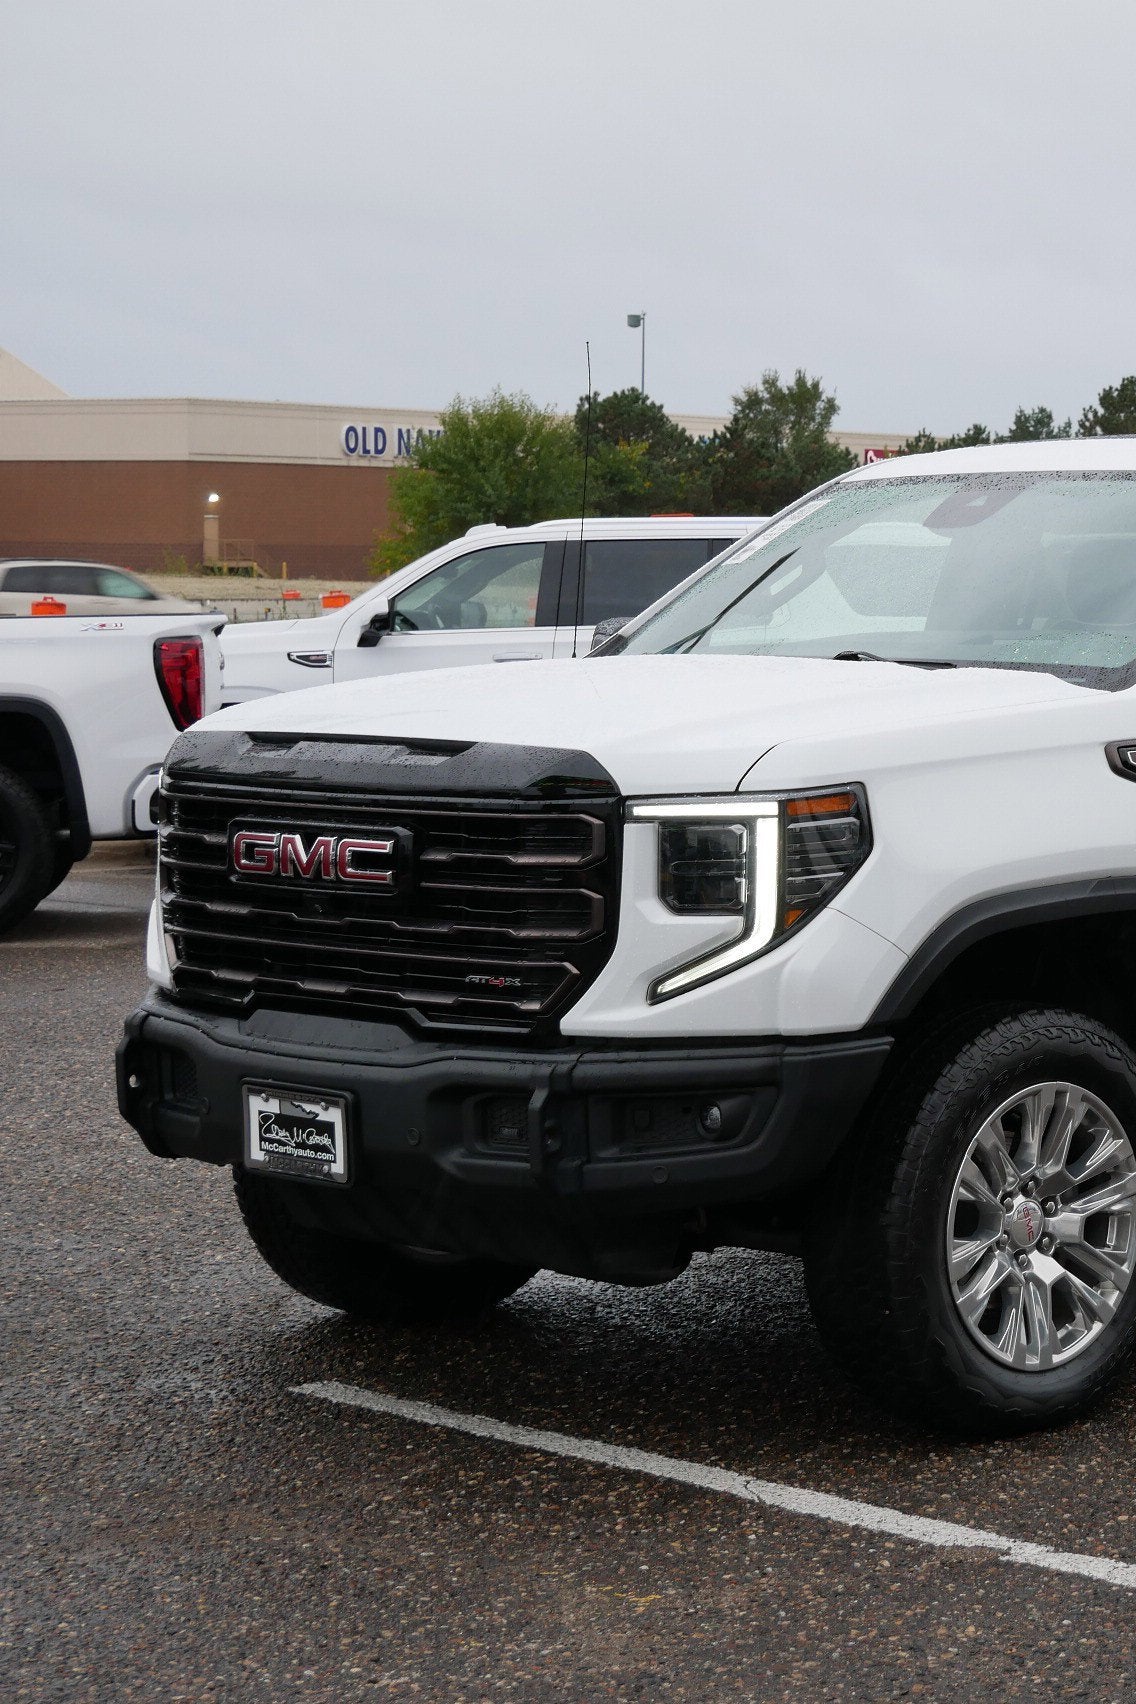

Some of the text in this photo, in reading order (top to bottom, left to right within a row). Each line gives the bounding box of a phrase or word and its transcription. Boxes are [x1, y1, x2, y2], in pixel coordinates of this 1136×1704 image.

[344, 425, 387, 456] OLD
[233, 831, 395, 884] GMC
[465, 975, 521, 987] AT4X
[261, 1140, 335, 1161] McCarthyauto.com
[1022, 1205, 1035, 1242] GMC
